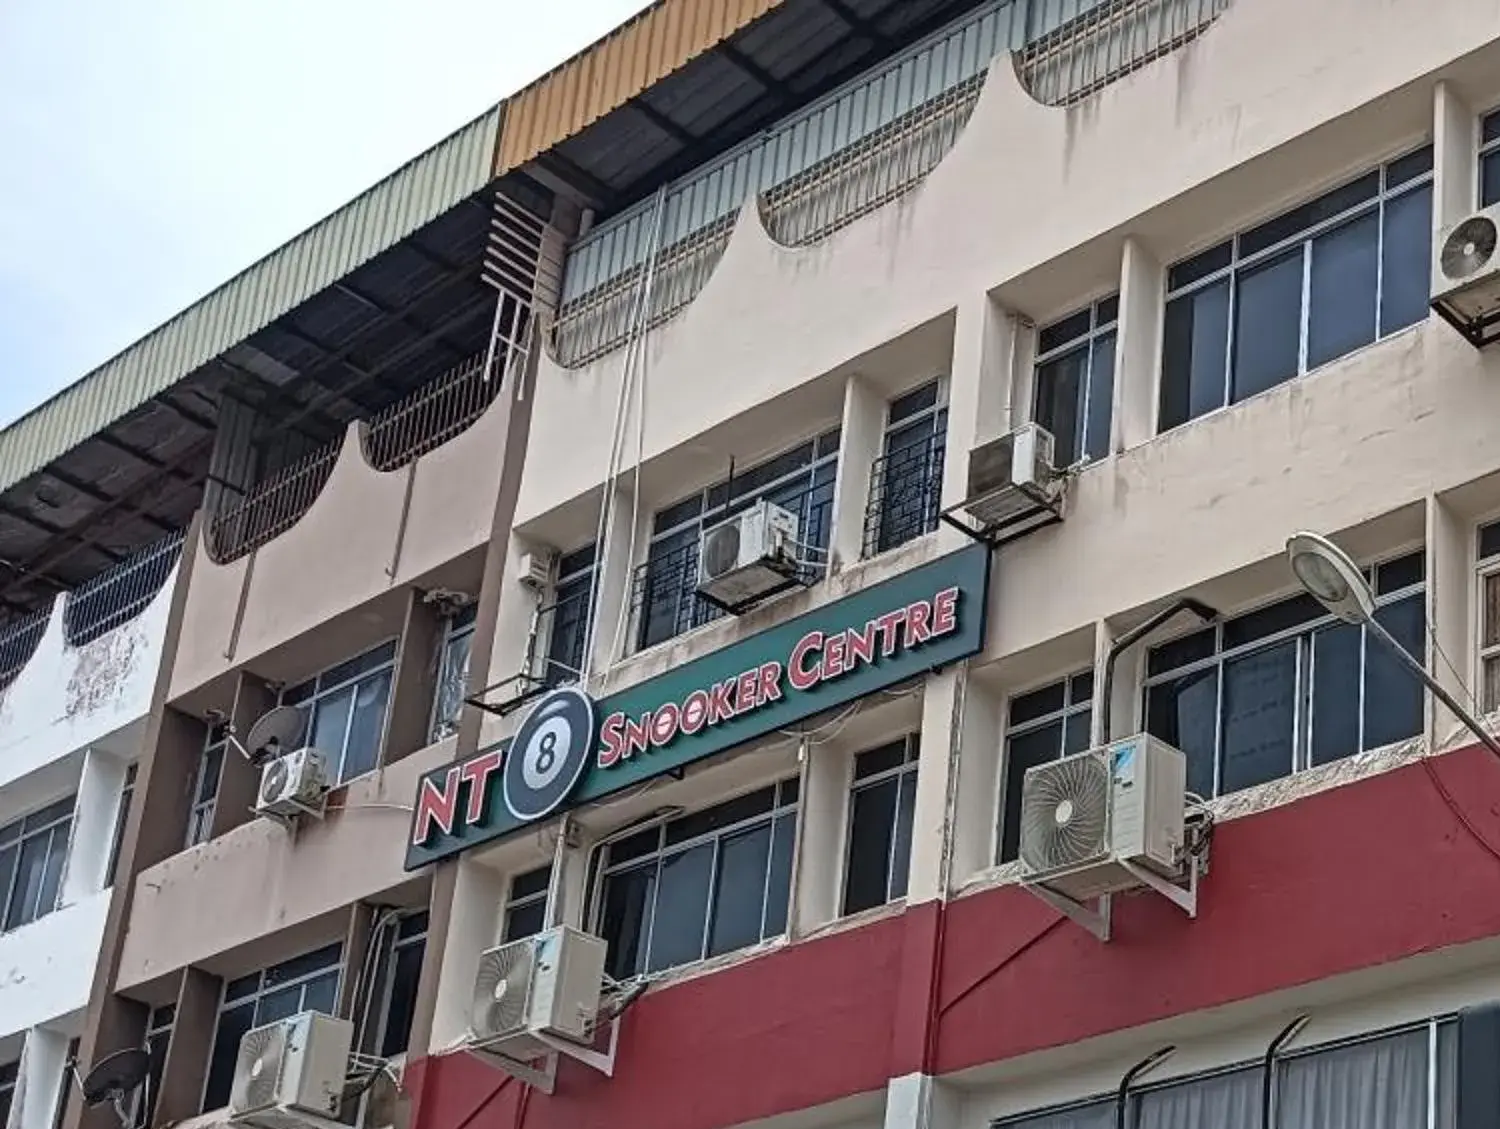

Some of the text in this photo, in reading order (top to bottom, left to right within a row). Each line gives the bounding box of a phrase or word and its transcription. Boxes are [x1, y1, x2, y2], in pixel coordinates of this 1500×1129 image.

[412, 587, 960, 846] NT 8 SNOOKER CENTRE
